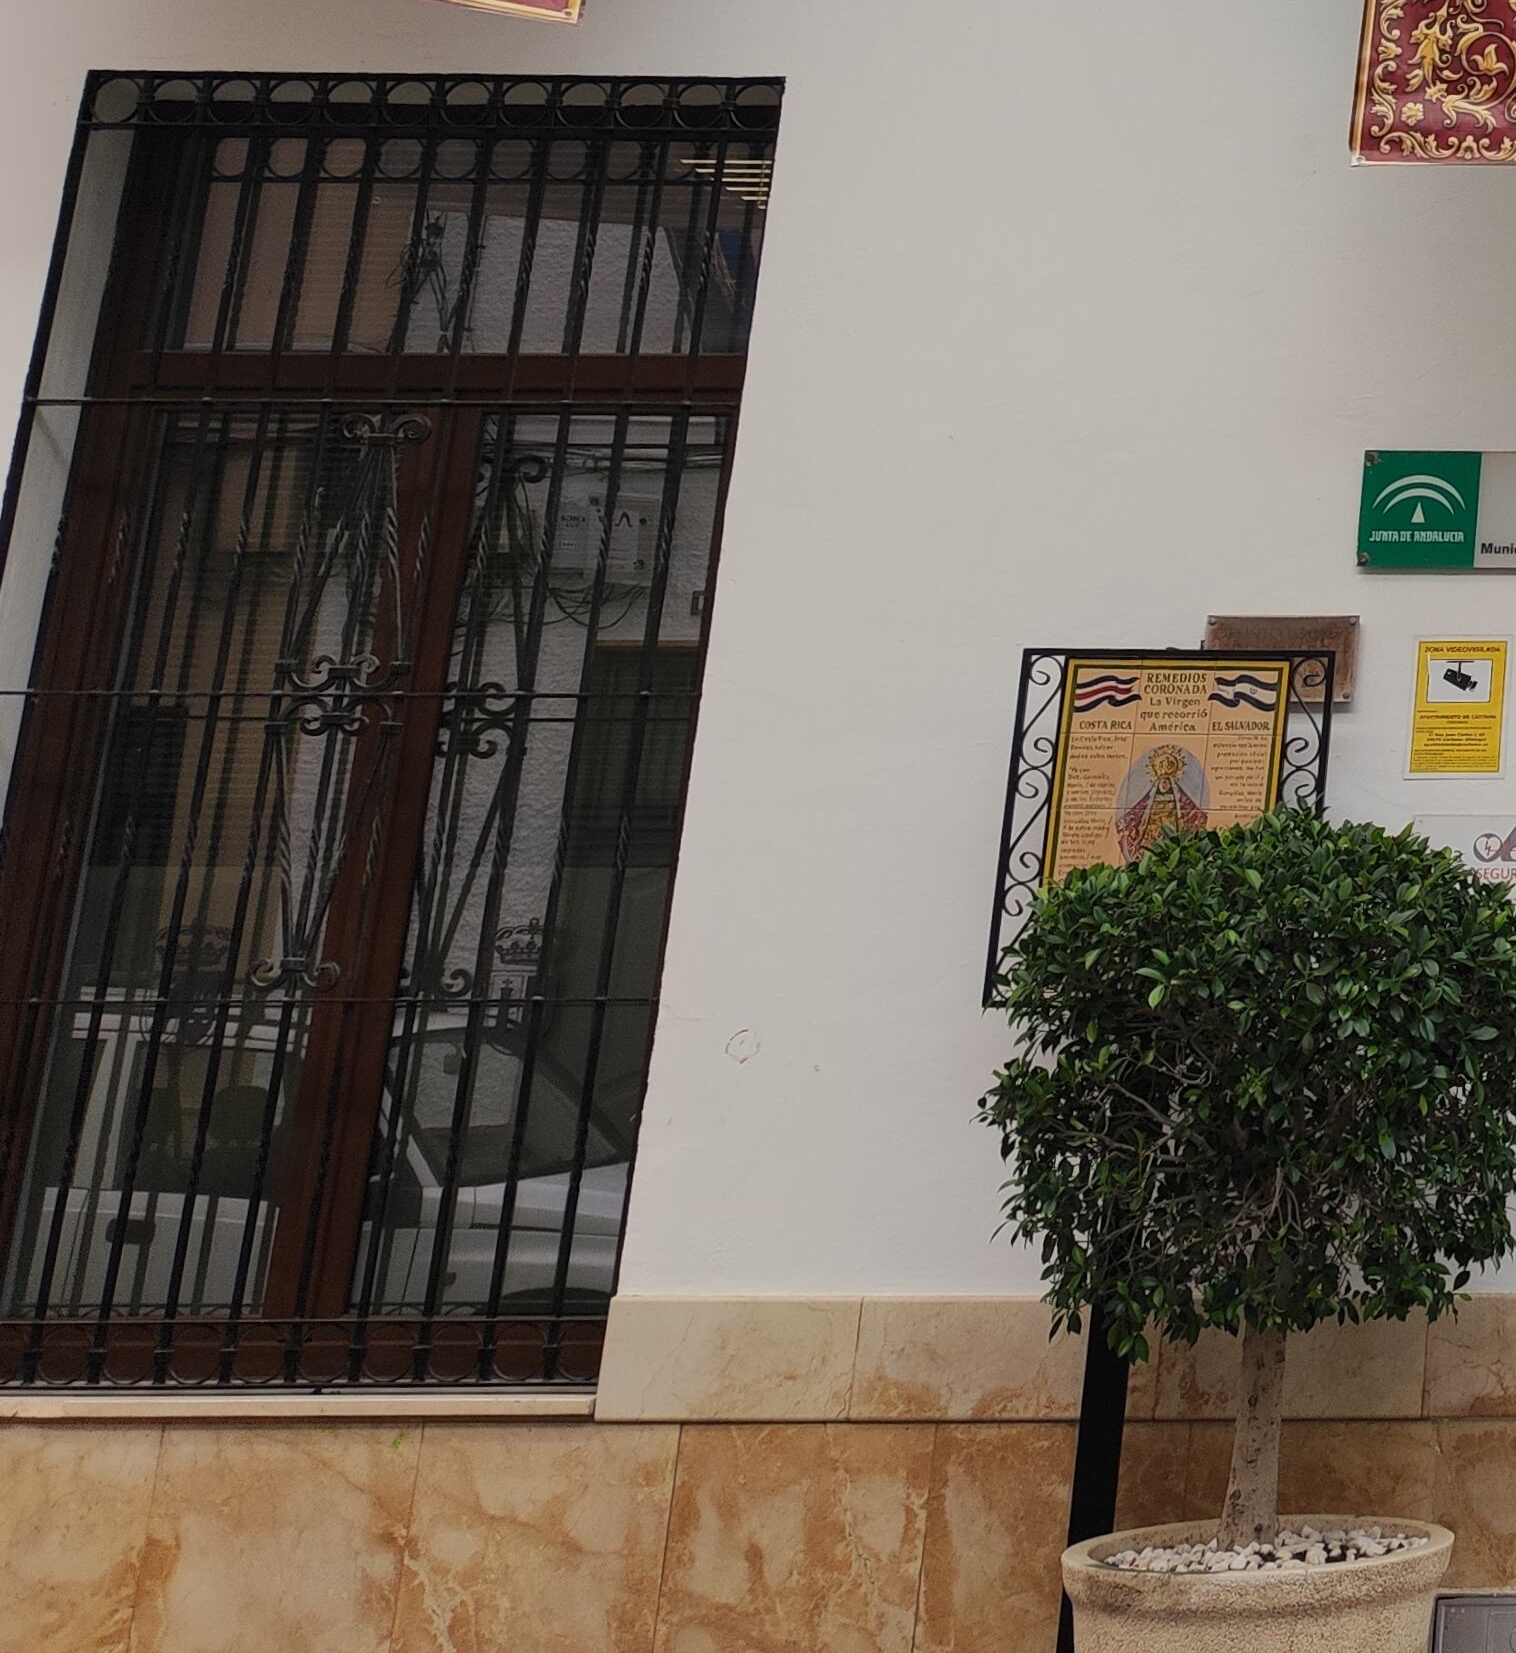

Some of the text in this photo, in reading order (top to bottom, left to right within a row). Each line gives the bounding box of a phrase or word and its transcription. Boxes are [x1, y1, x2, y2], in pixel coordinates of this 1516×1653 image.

[1369, 531, 1399, 542] JUNTA
[1400, 531, 1411, 541] DE
[1146, 672, 1207, 683] REMEDIOS
[1143, 684, 1208, 695] CORONADA
[1150, 696, 1201, 707] La Virgen
[1140, 708, 1208, 722] que recorrió
[1079, 721, 1132, 730] COSTA RICA
[1150, 721, 1196, 732] América
[1212, 720, 1271, 732] EL SALVADOR
